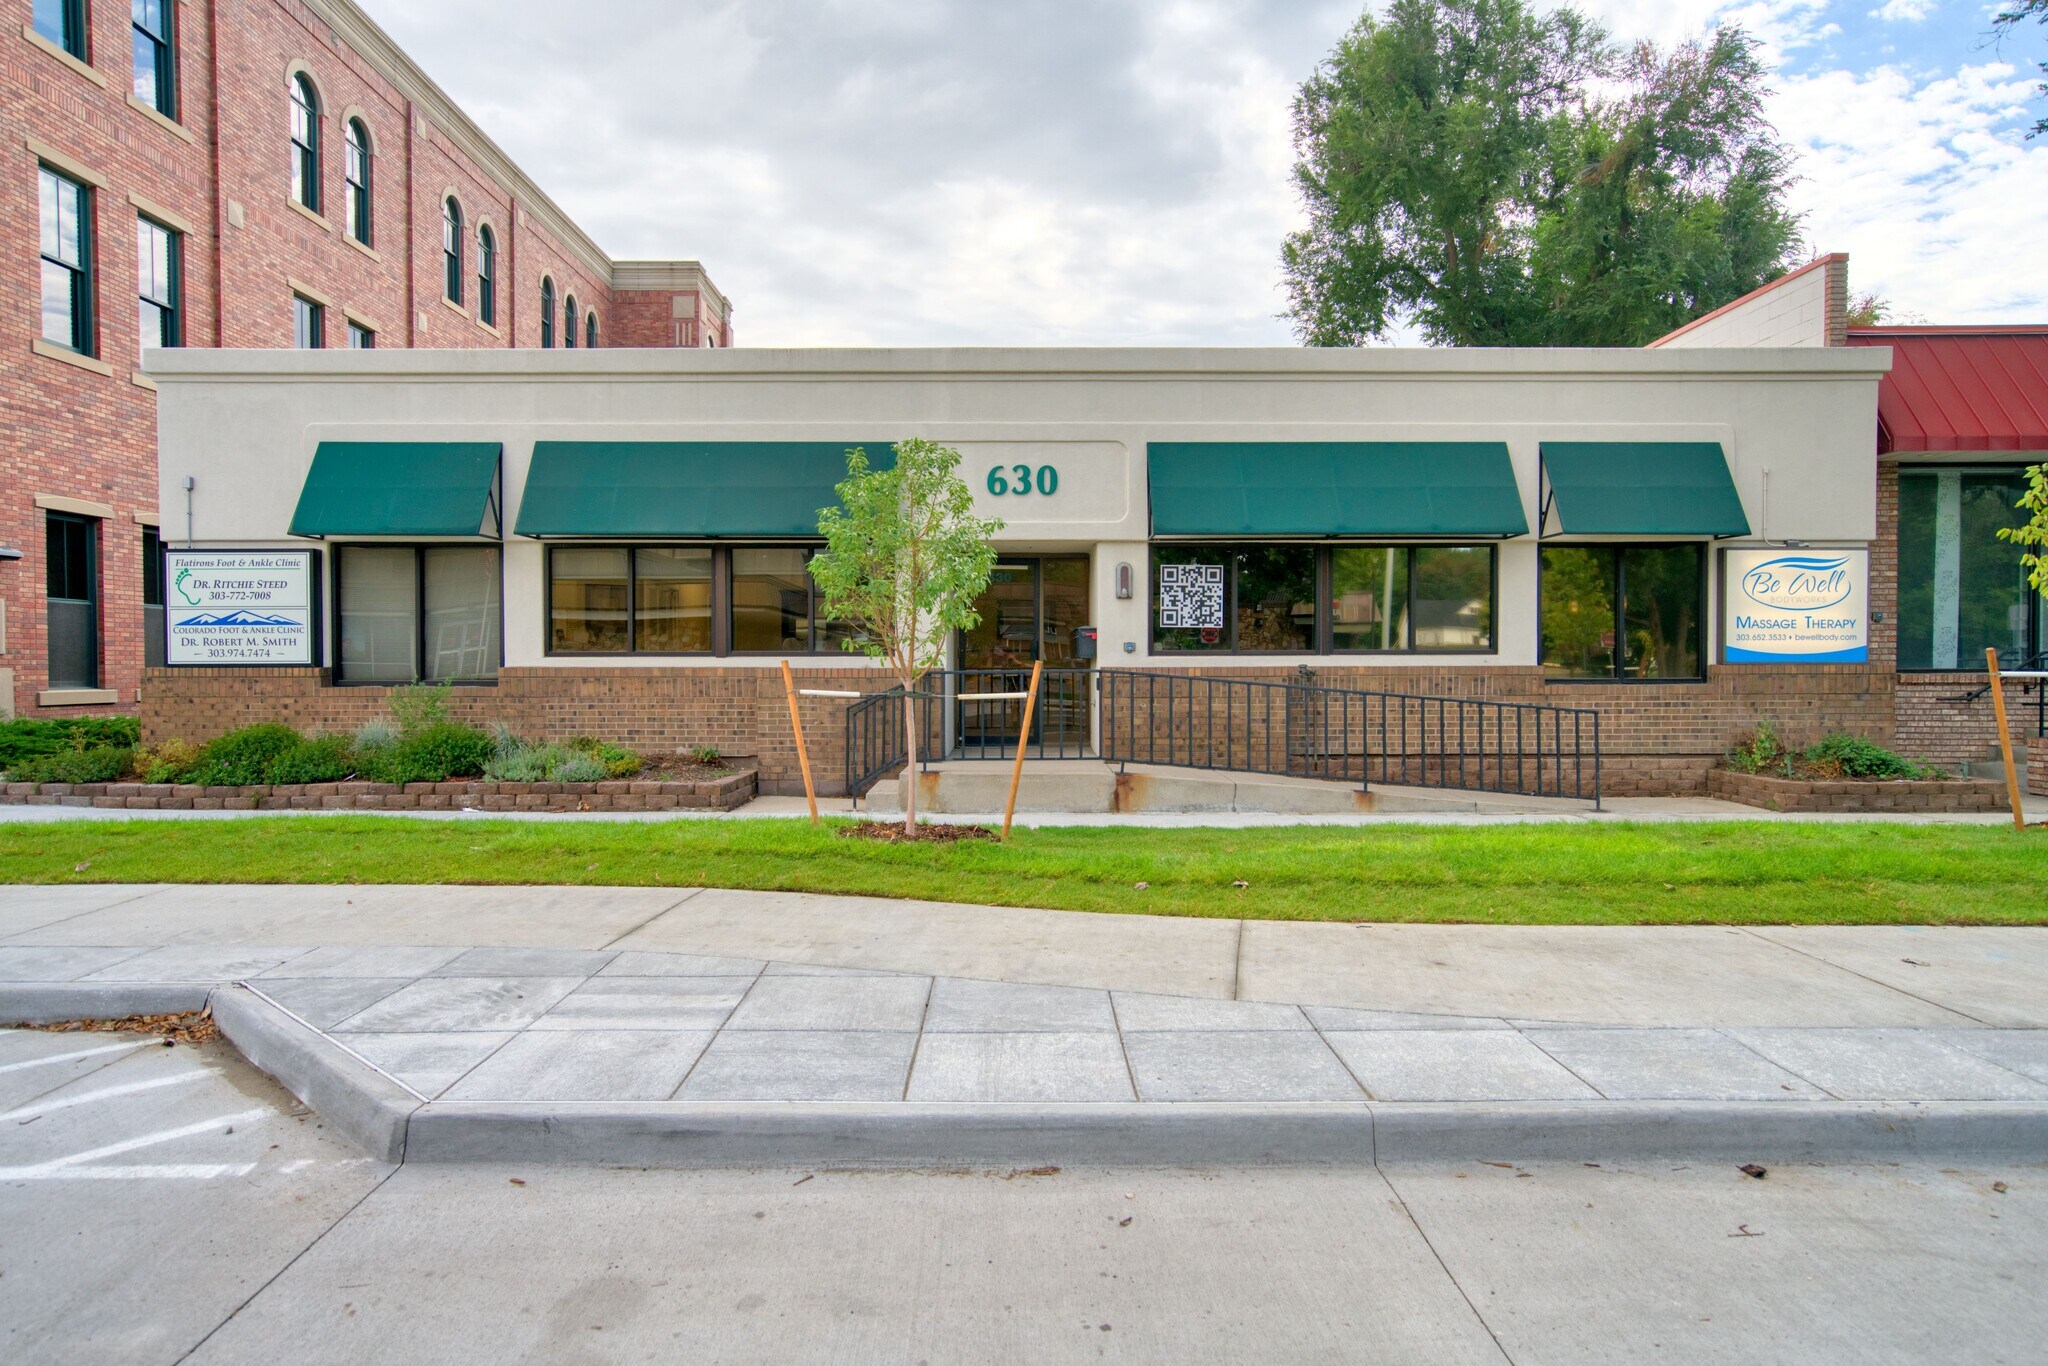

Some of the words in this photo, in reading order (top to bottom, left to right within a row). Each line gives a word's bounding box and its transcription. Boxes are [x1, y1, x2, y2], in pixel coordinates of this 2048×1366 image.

[987, 464, 1058, 496] 630
[175, 559, 215, 567] Flatirons
[217, 559, 236, 567] Foot
[238, 559, 247, 567] &
[248, 559, 274, 567] Ankle
[275, 559, 302, 567] Clinic
[193, 580, 211, 589] DR.
[213, 580, 255, 589] RITCHIE
[256, 580, 288, 589] STEED
[1750, 572, 1781, 596] Be
[1788, 570, 1846, 595] Well
[208, 591, 272, 600] 303-772-7008
[1736, 616, 1797, 629] MASSAGE
[1805, 616, 1856, 629] THERAPY
[172, 626, 217, 634] COLORADO
[218, 626, 240, 634] FOOT
[241, 626, 249, 634] &
[250, 626, 275, 634] ANKLE
[276, 626, 305, 634] CLINIC
[181, 637, 200, 647] DR.
[202, 637, 244, 647] ROBERT
[246, 637, 260, 647] M.
[262, 637, 297, 647] SMITH
[1736, 633, 1787, 641] 303.652.3533
[1794, 633, 1858, 642] bewellbody.com
[207, 649, 271, 658] 303.974.7474
